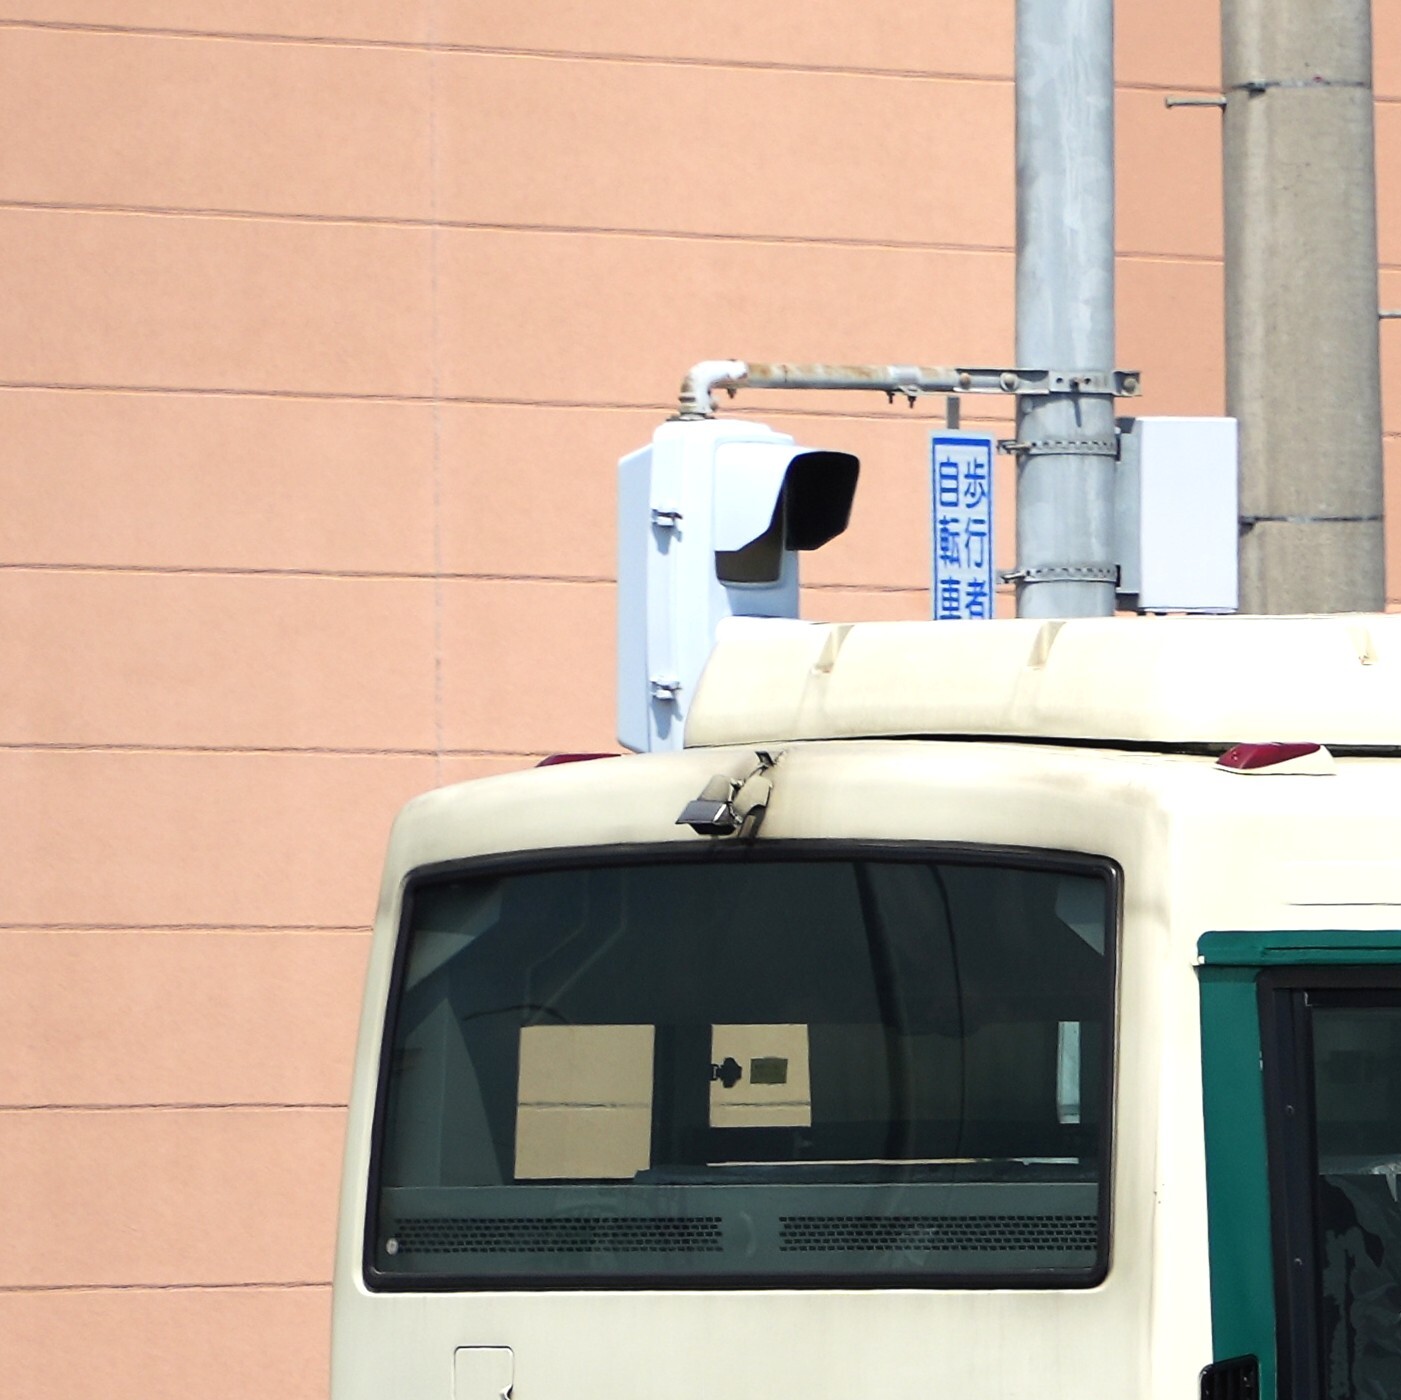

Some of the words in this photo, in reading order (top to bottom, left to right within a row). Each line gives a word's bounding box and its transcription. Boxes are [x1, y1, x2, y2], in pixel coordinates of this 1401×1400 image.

[939, 457, 961, 619] 自転車
[964, 457, 987, 619] 歩行者
